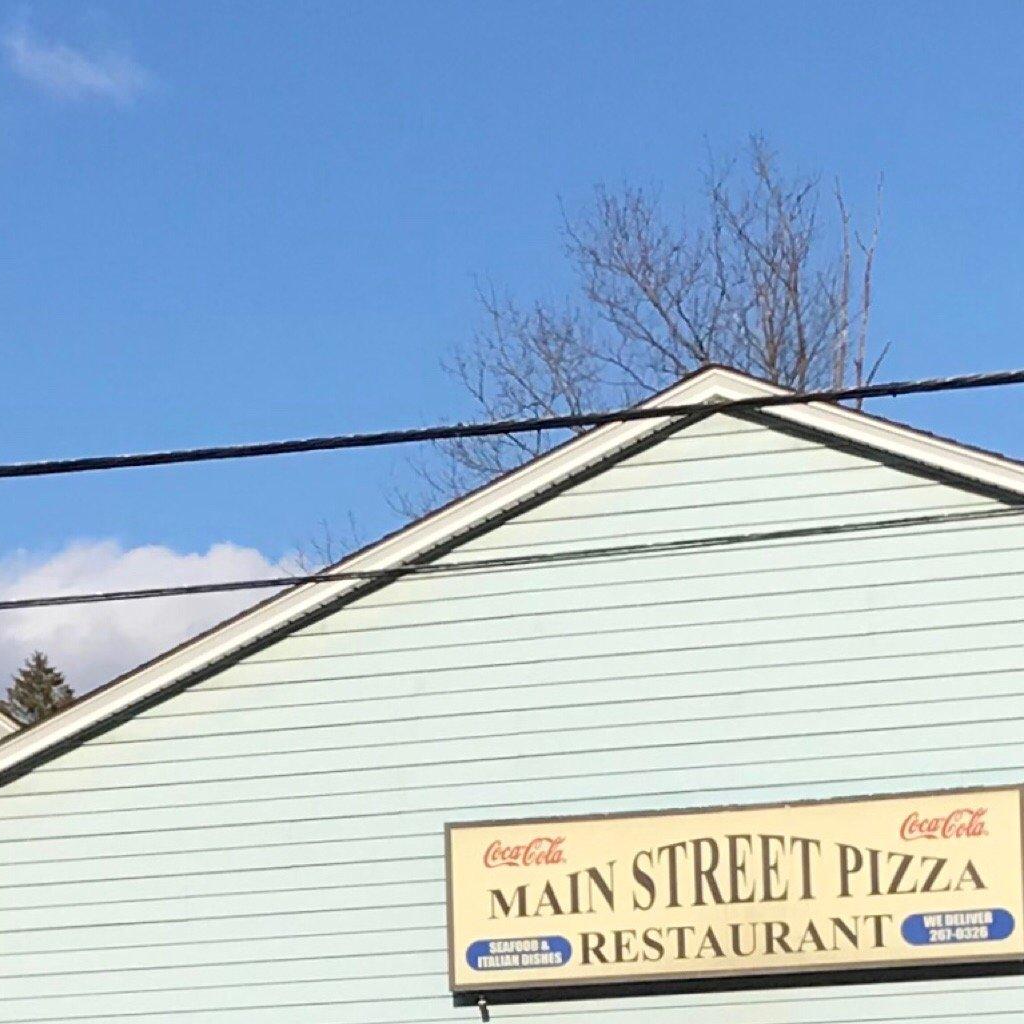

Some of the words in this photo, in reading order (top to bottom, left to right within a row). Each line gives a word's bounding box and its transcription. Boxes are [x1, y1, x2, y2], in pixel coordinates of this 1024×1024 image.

[487, 860, 617, 919] MAIN
[632, 833, 821, 911] STREET
[835, 842, 988, 897] PIZZA
[923, 914, 943, 928] WE
[944, 911, 993, 926] DELIVER
[489, 939, 539, 953] SEAFOOD
[541, 940, 550, 950] &
[578, 914, 892, 965] RESTAURANT
[478, 954, 520, 968] ITALIAN
[522, 952, 562, 966] DISHES
